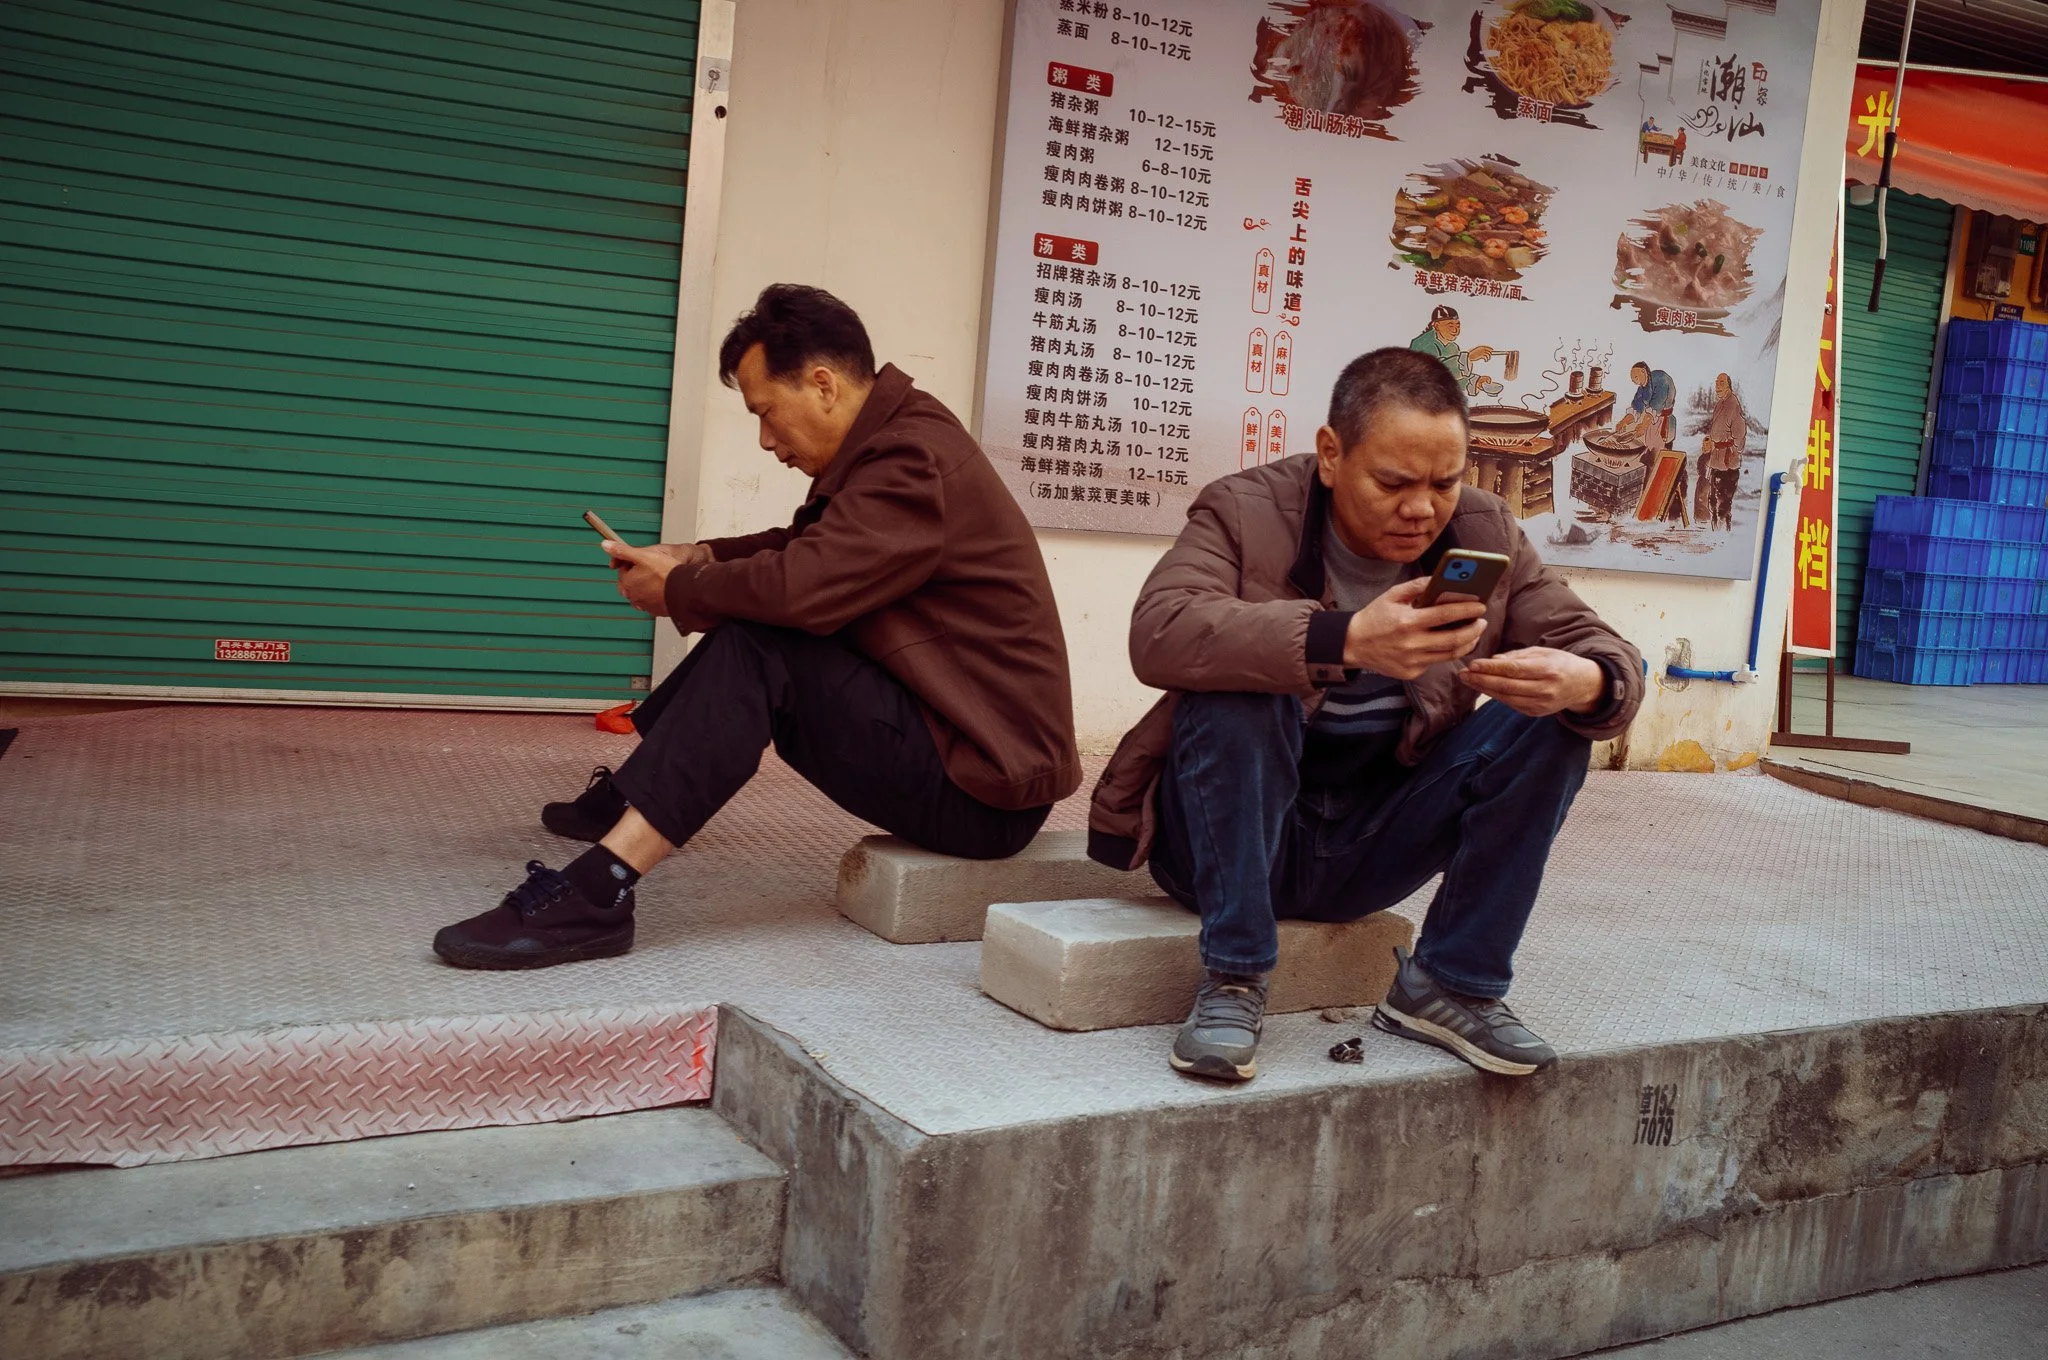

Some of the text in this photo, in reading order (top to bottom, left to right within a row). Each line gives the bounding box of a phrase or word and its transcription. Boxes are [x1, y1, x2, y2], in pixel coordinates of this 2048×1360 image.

[1112, 7, 1193, 38] 8-10-12元
[1057, 18, 1191, 61] 蒸面 8-10-12元
[1052, 66, 1102, 92] 粥类
[1050, 91, 1217, 138] 猪杂粥 10-12-15元
[1284, 105, 1365, 139] 潮汕肠粉
[1517, 97, 1554, 122] 蒸面
[1048, 115, 1214, 161] 海鲜猪杂粥 12-15元
[1046, 140, 1212, 185] 瘦肉粥 6-8-10元
[1690, 155, 1726, 173] 美食文化
[1044, 164, 1210, 208] 瘦肉肉卷粥 8-10-12元
[1042, 189, 1208, 231] 瘦肉肉饼粥 8-10-12元
[1038, 237, 1087, 260] 汤类
[1283, 177, 1312, 312] 舌尖上的味道
[1036, 261, 1201, 301] 招牌猪杂汤 8-10-12元
[1257, 264, 1270, 294] 真材
[1414, 270, 1523, 300] 海鲜猪杂汤粉/面
[1034, 286, 1083, 309] 瘦肉汤
[1032, 311, 1198, 348] 牛筋丸汤 8-10-12元
[1657, 308, 1697, 327] 瘦肉粥
[1030, 335, 1096, 359] 猪肉丸汤
[1251, 344, 1263, 373] 真材
[1028, 359, 1194, 394] 瘦肉肉卷汤 8-10-12元
[1026, 383, 1193, 417] 瘦肉肉饼汤 10-12元
[1024, 408, 1190, 440] 瘦肉牛筋丸汤 10-12元
[1245, 423, 1257, 452] 鲜香
[1022, 432, 1121, 457] 瘦肉猪肉丸汤
[1270, 425, 1282, 454] 美味
[1020, 456, 1189, 486] 海鲜猪杂汤 12-15元
[1798, 339, 1832, 591] 排档
[219, 649, 287, 660] 13288676711
